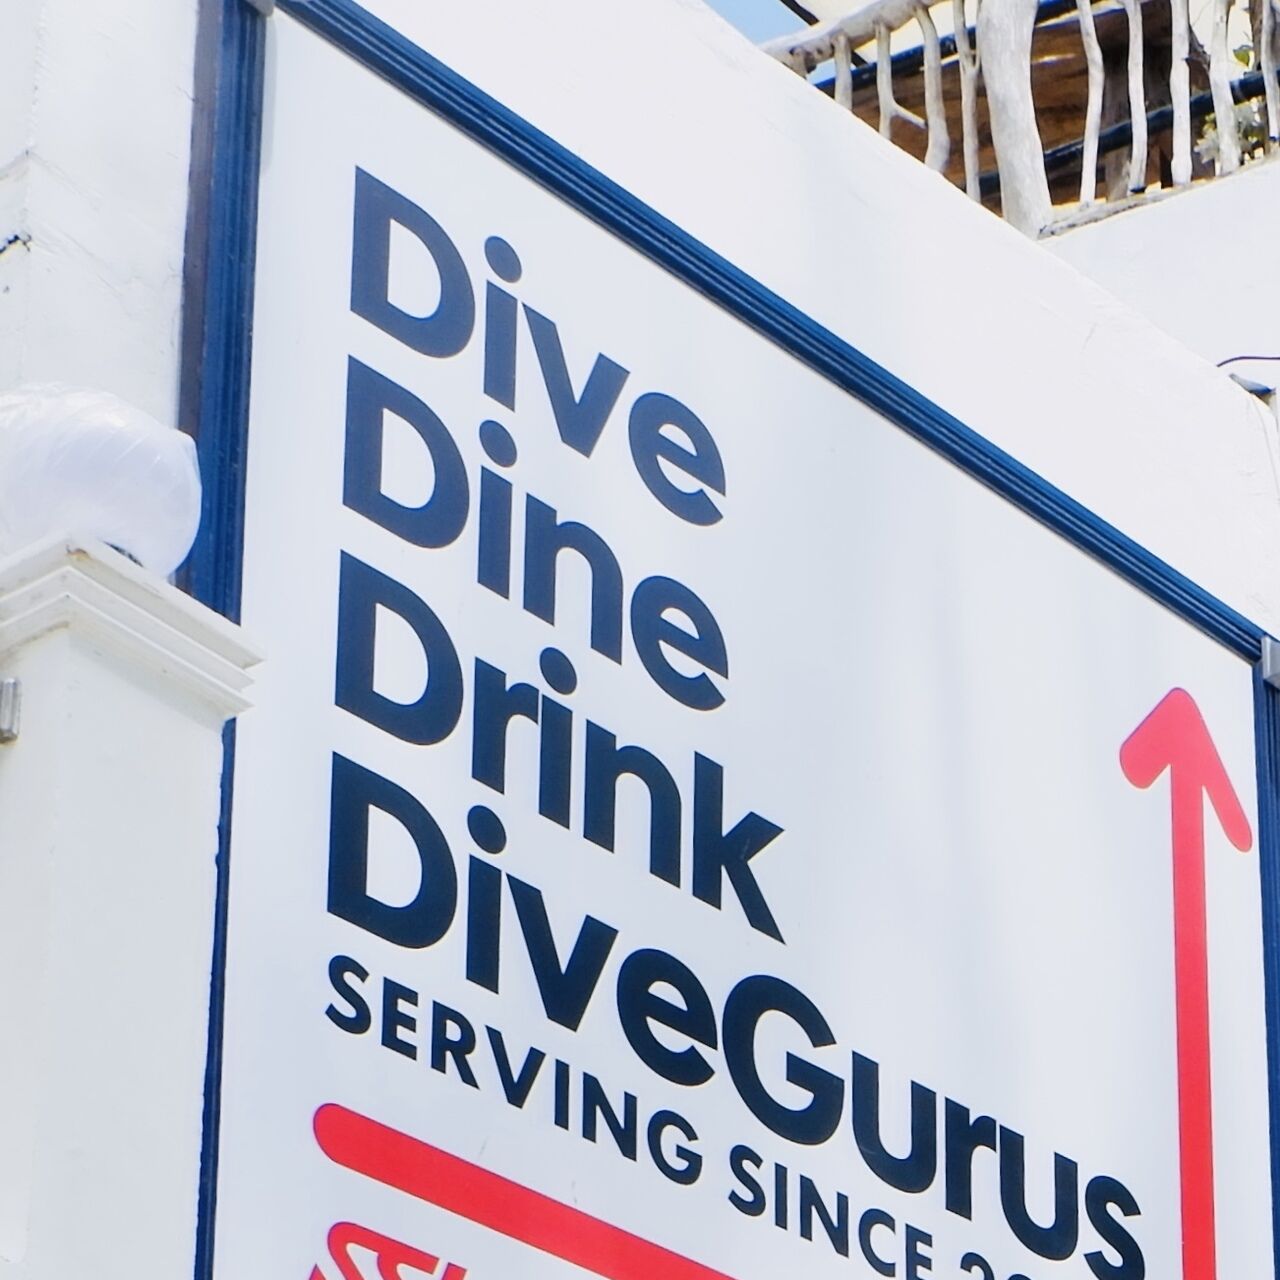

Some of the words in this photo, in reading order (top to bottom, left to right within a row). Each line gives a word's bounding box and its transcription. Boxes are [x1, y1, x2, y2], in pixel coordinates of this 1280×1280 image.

[350, 165, 727, 526] Dive
[343, 354, 729, 711] Dine
[334, 549, 786, 944] Drink
[325, 955, 703, 1186] SERVING
